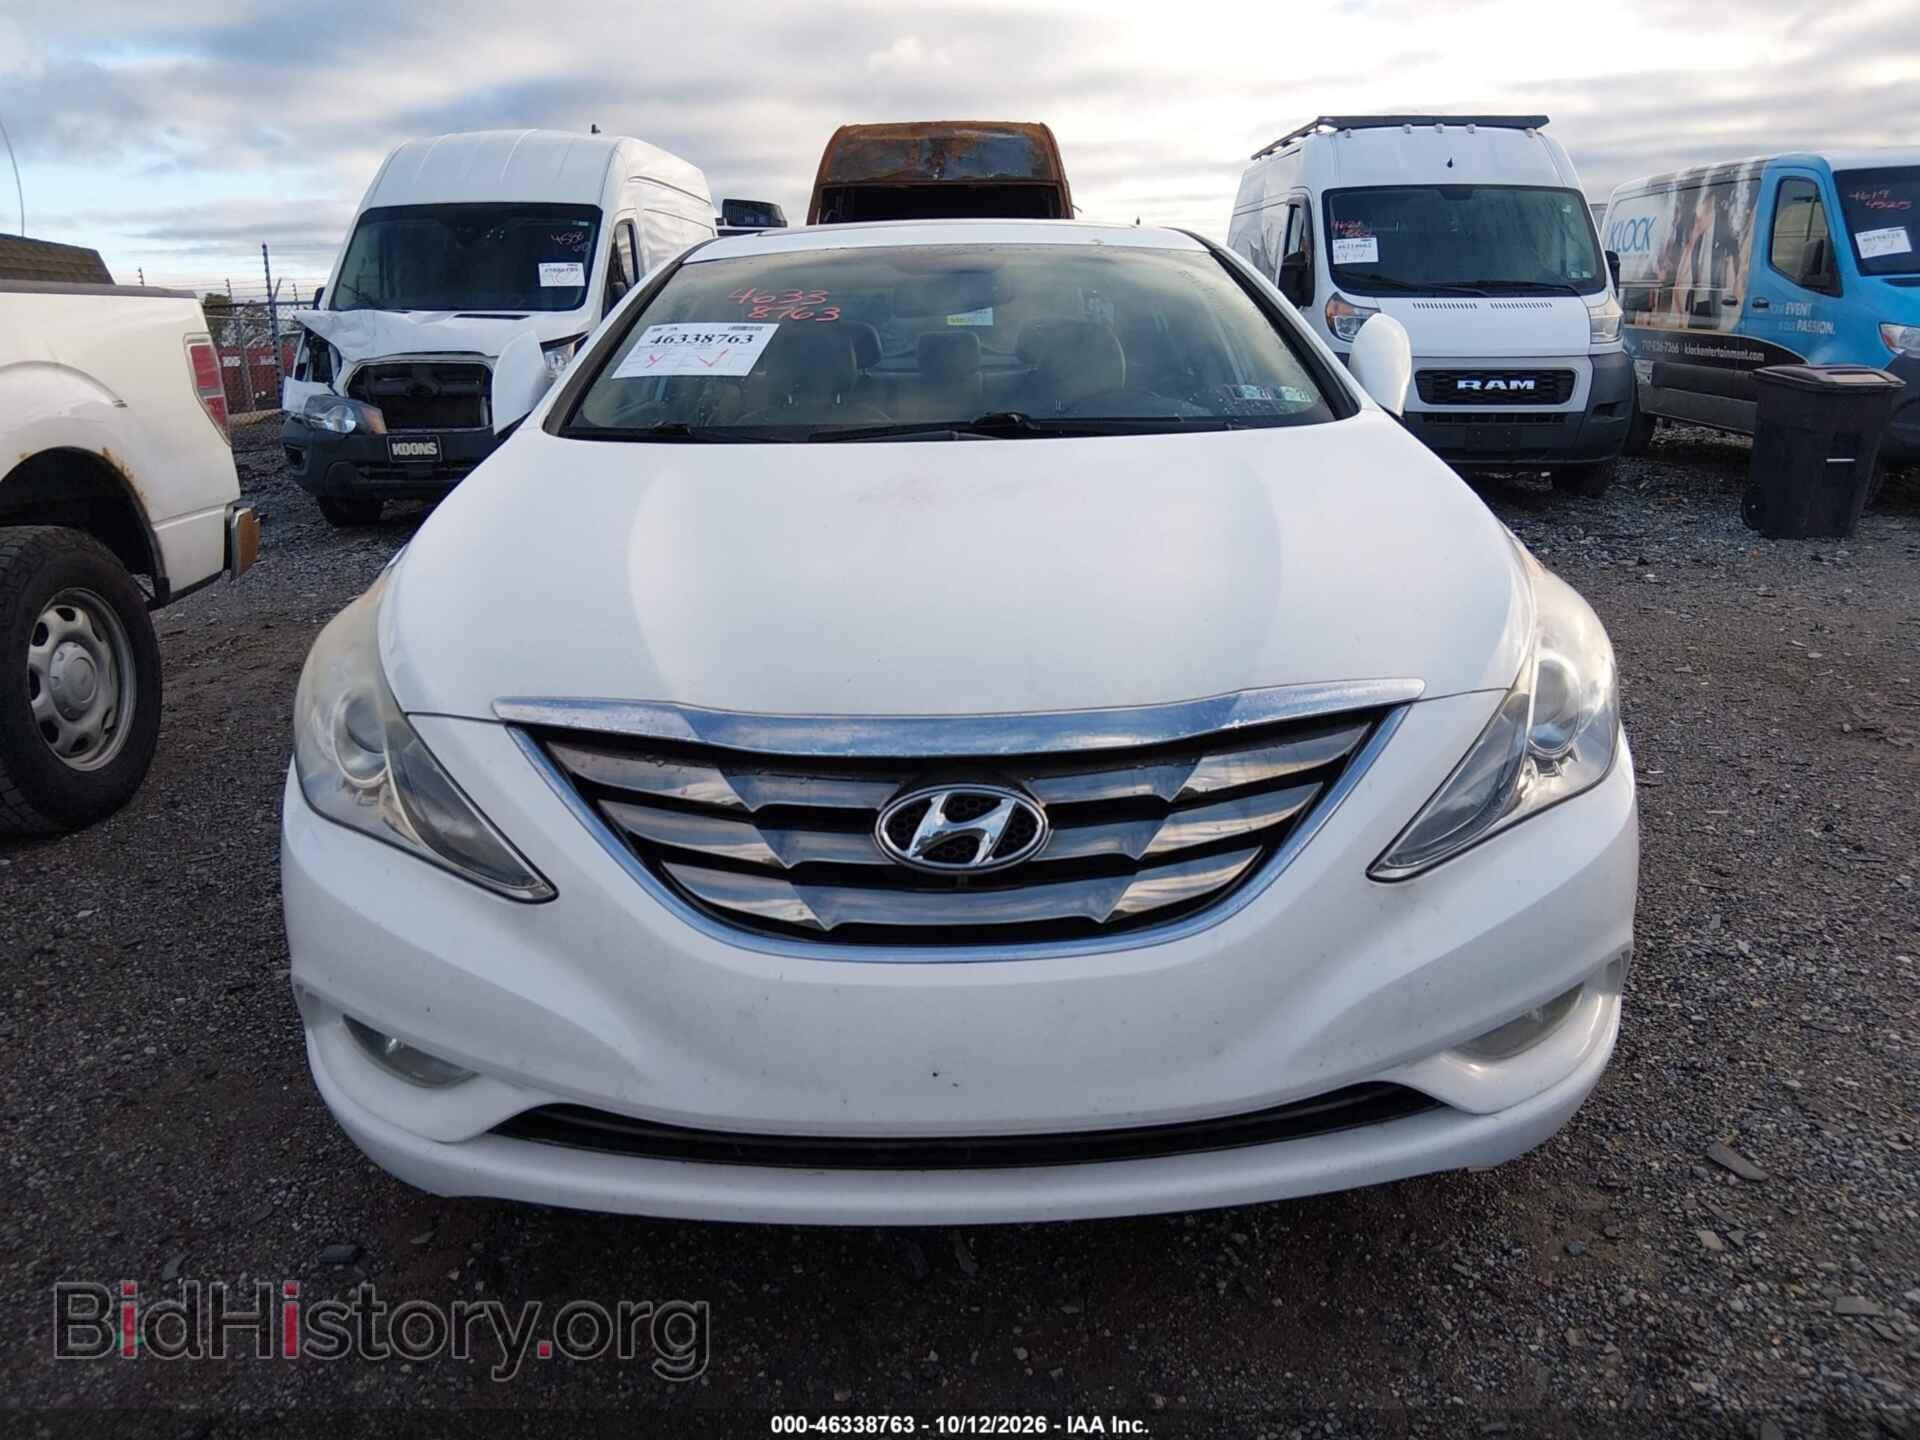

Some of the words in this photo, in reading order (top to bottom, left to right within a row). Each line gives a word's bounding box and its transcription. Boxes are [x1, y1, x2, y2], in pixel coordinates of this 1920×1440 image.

[728, 288, 830, 305] 4633
[747, 304, 840, 321] 8763
[649, 333, 755, 345] 46338763
[1457, 379, 1535, 391] RAM
[392, 442, 437, 456] KOONS
